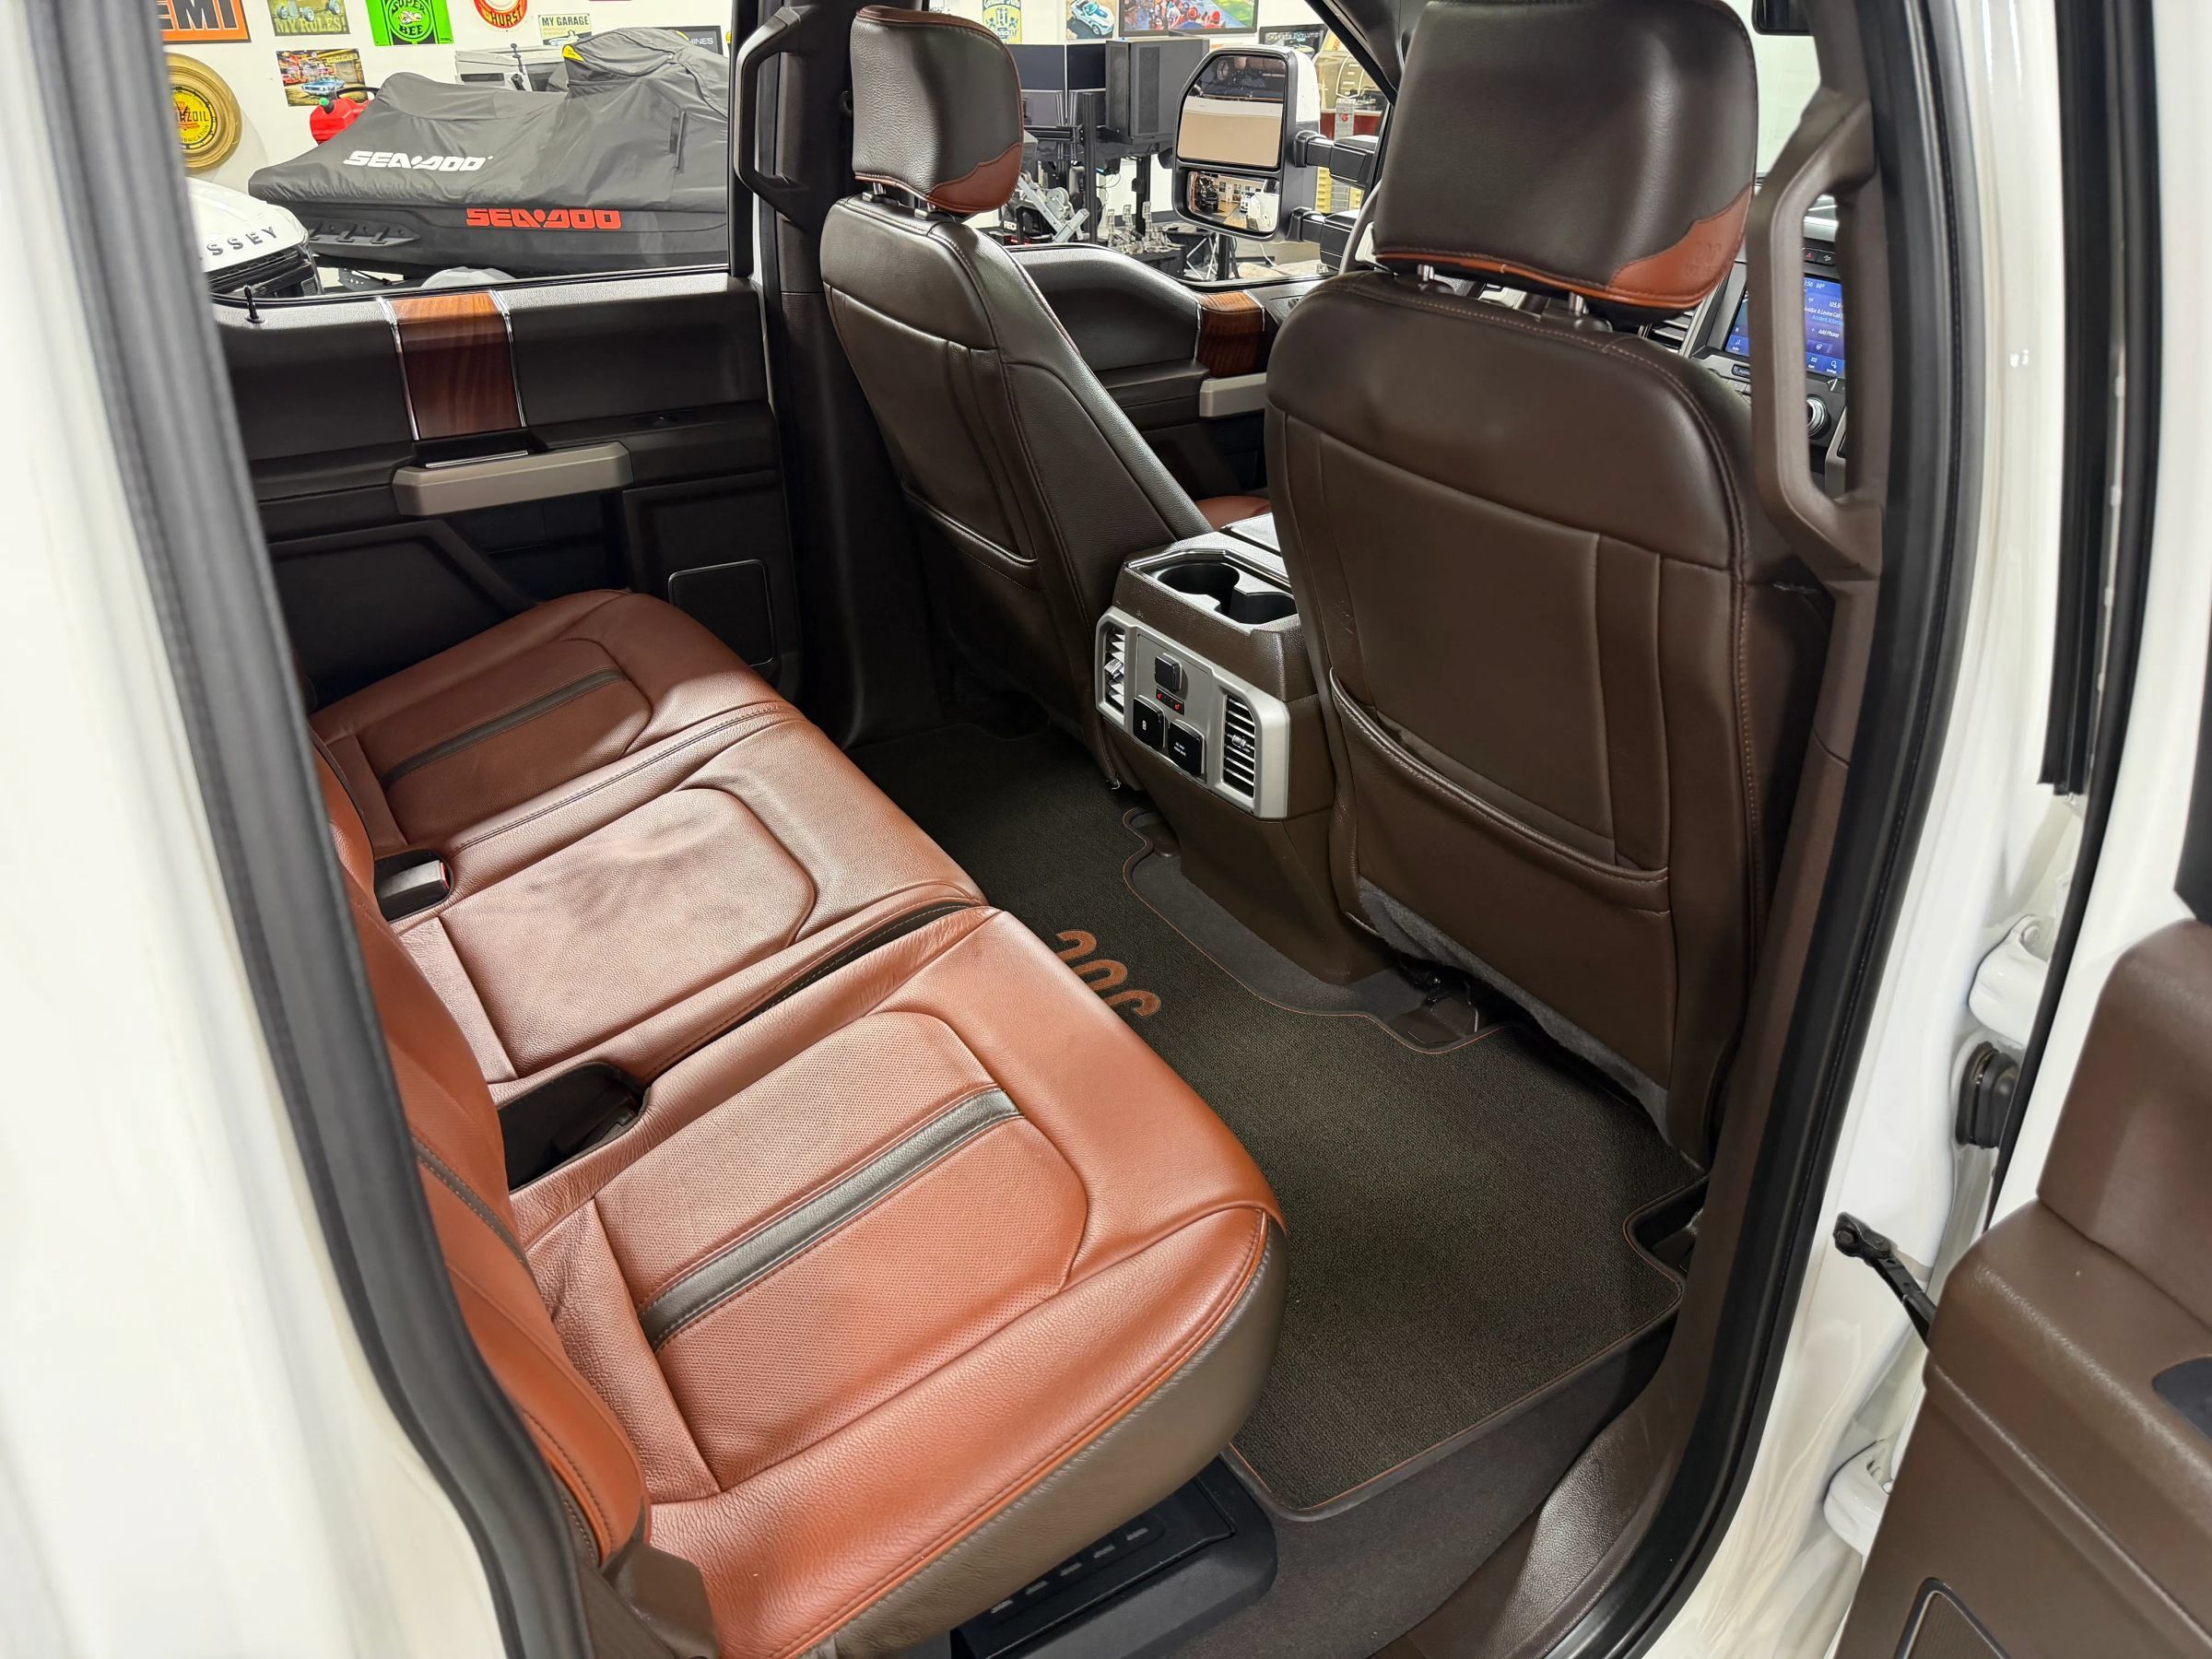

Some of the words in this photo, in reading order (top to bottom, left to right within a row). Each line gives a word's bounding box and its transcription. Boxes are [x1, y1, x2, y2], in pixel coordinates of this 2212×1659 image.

[489, 5, 522, 26] HURST
[542, 18, 554, 26] MY
[557, 16, 589, 26] GARAGE
[394, 25, 424, 35] BEE
